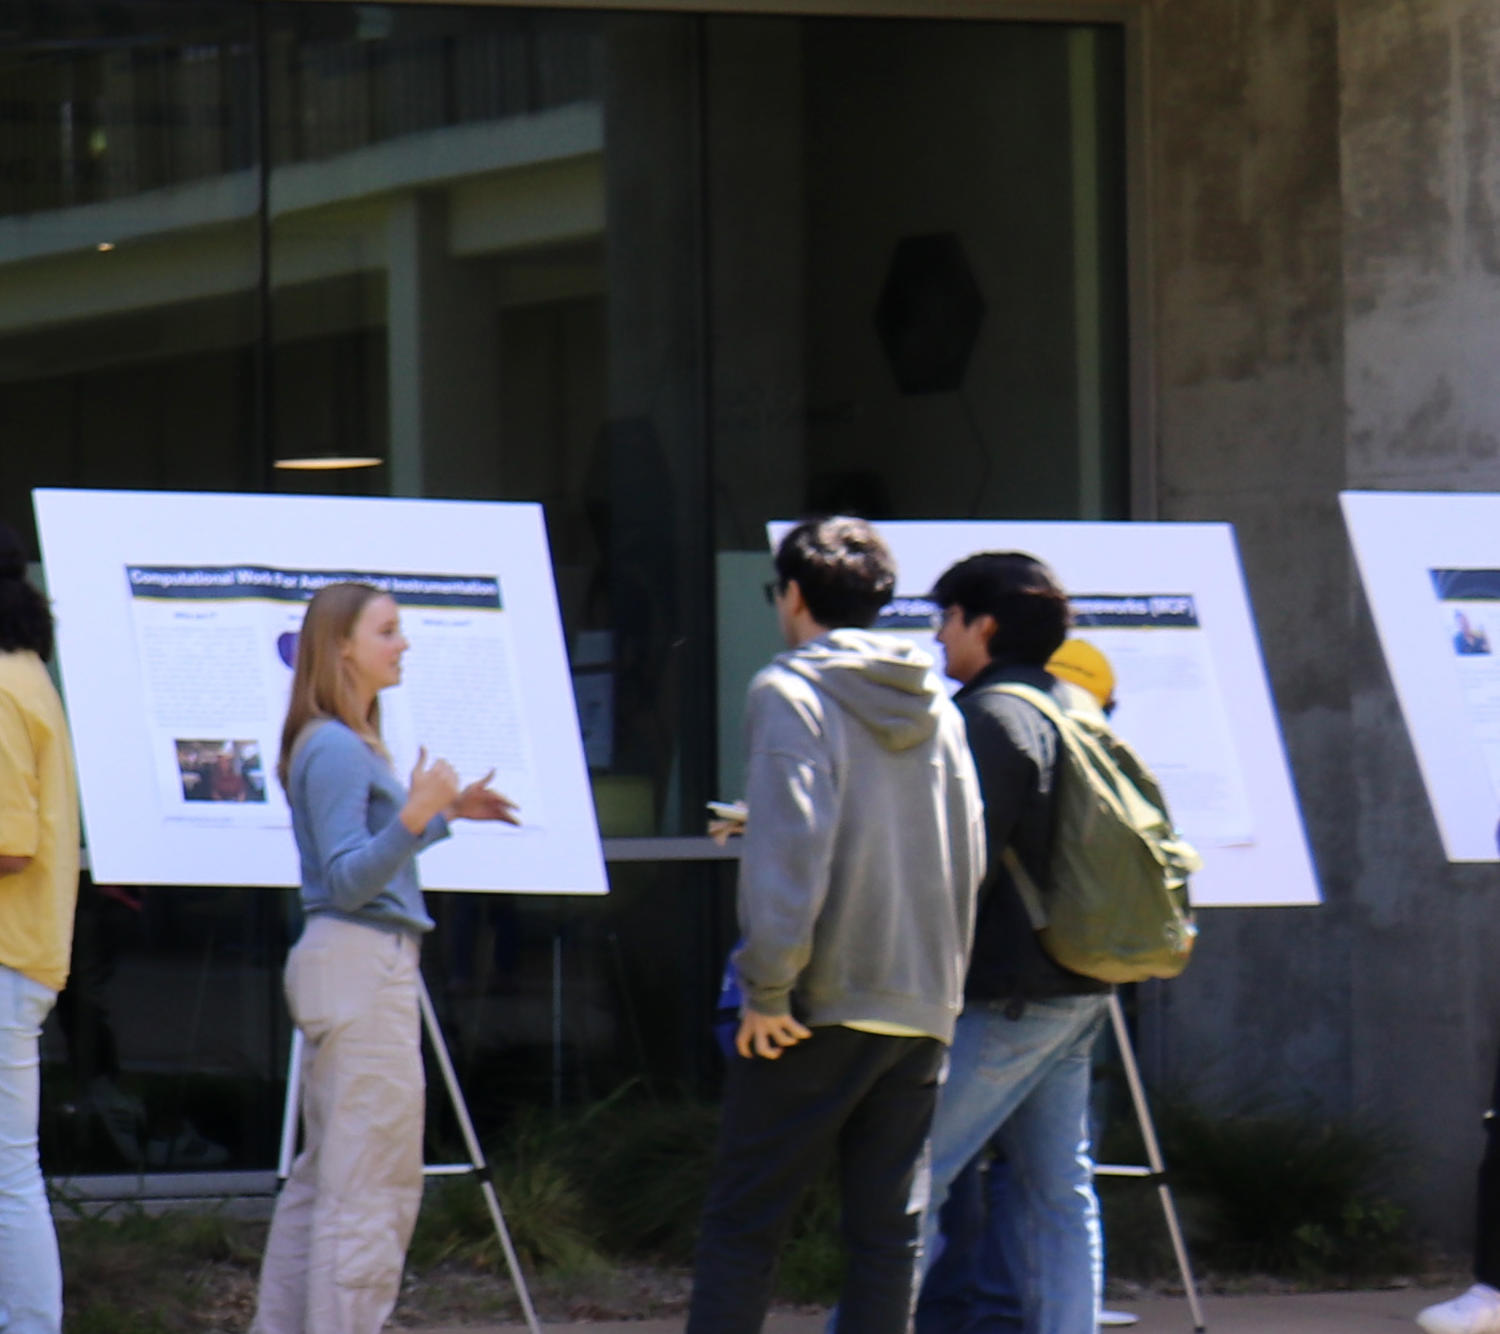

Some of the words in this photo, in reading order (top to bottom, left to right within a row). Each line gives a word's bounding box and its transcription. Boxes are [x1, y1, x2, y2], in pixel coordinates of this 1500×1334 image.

[131, 569, 235, 588] Computational
[236, 570, 274, 585] Work
[274, 573, 298, 588] For
[392, 578, 498, 596] Instrumentation
